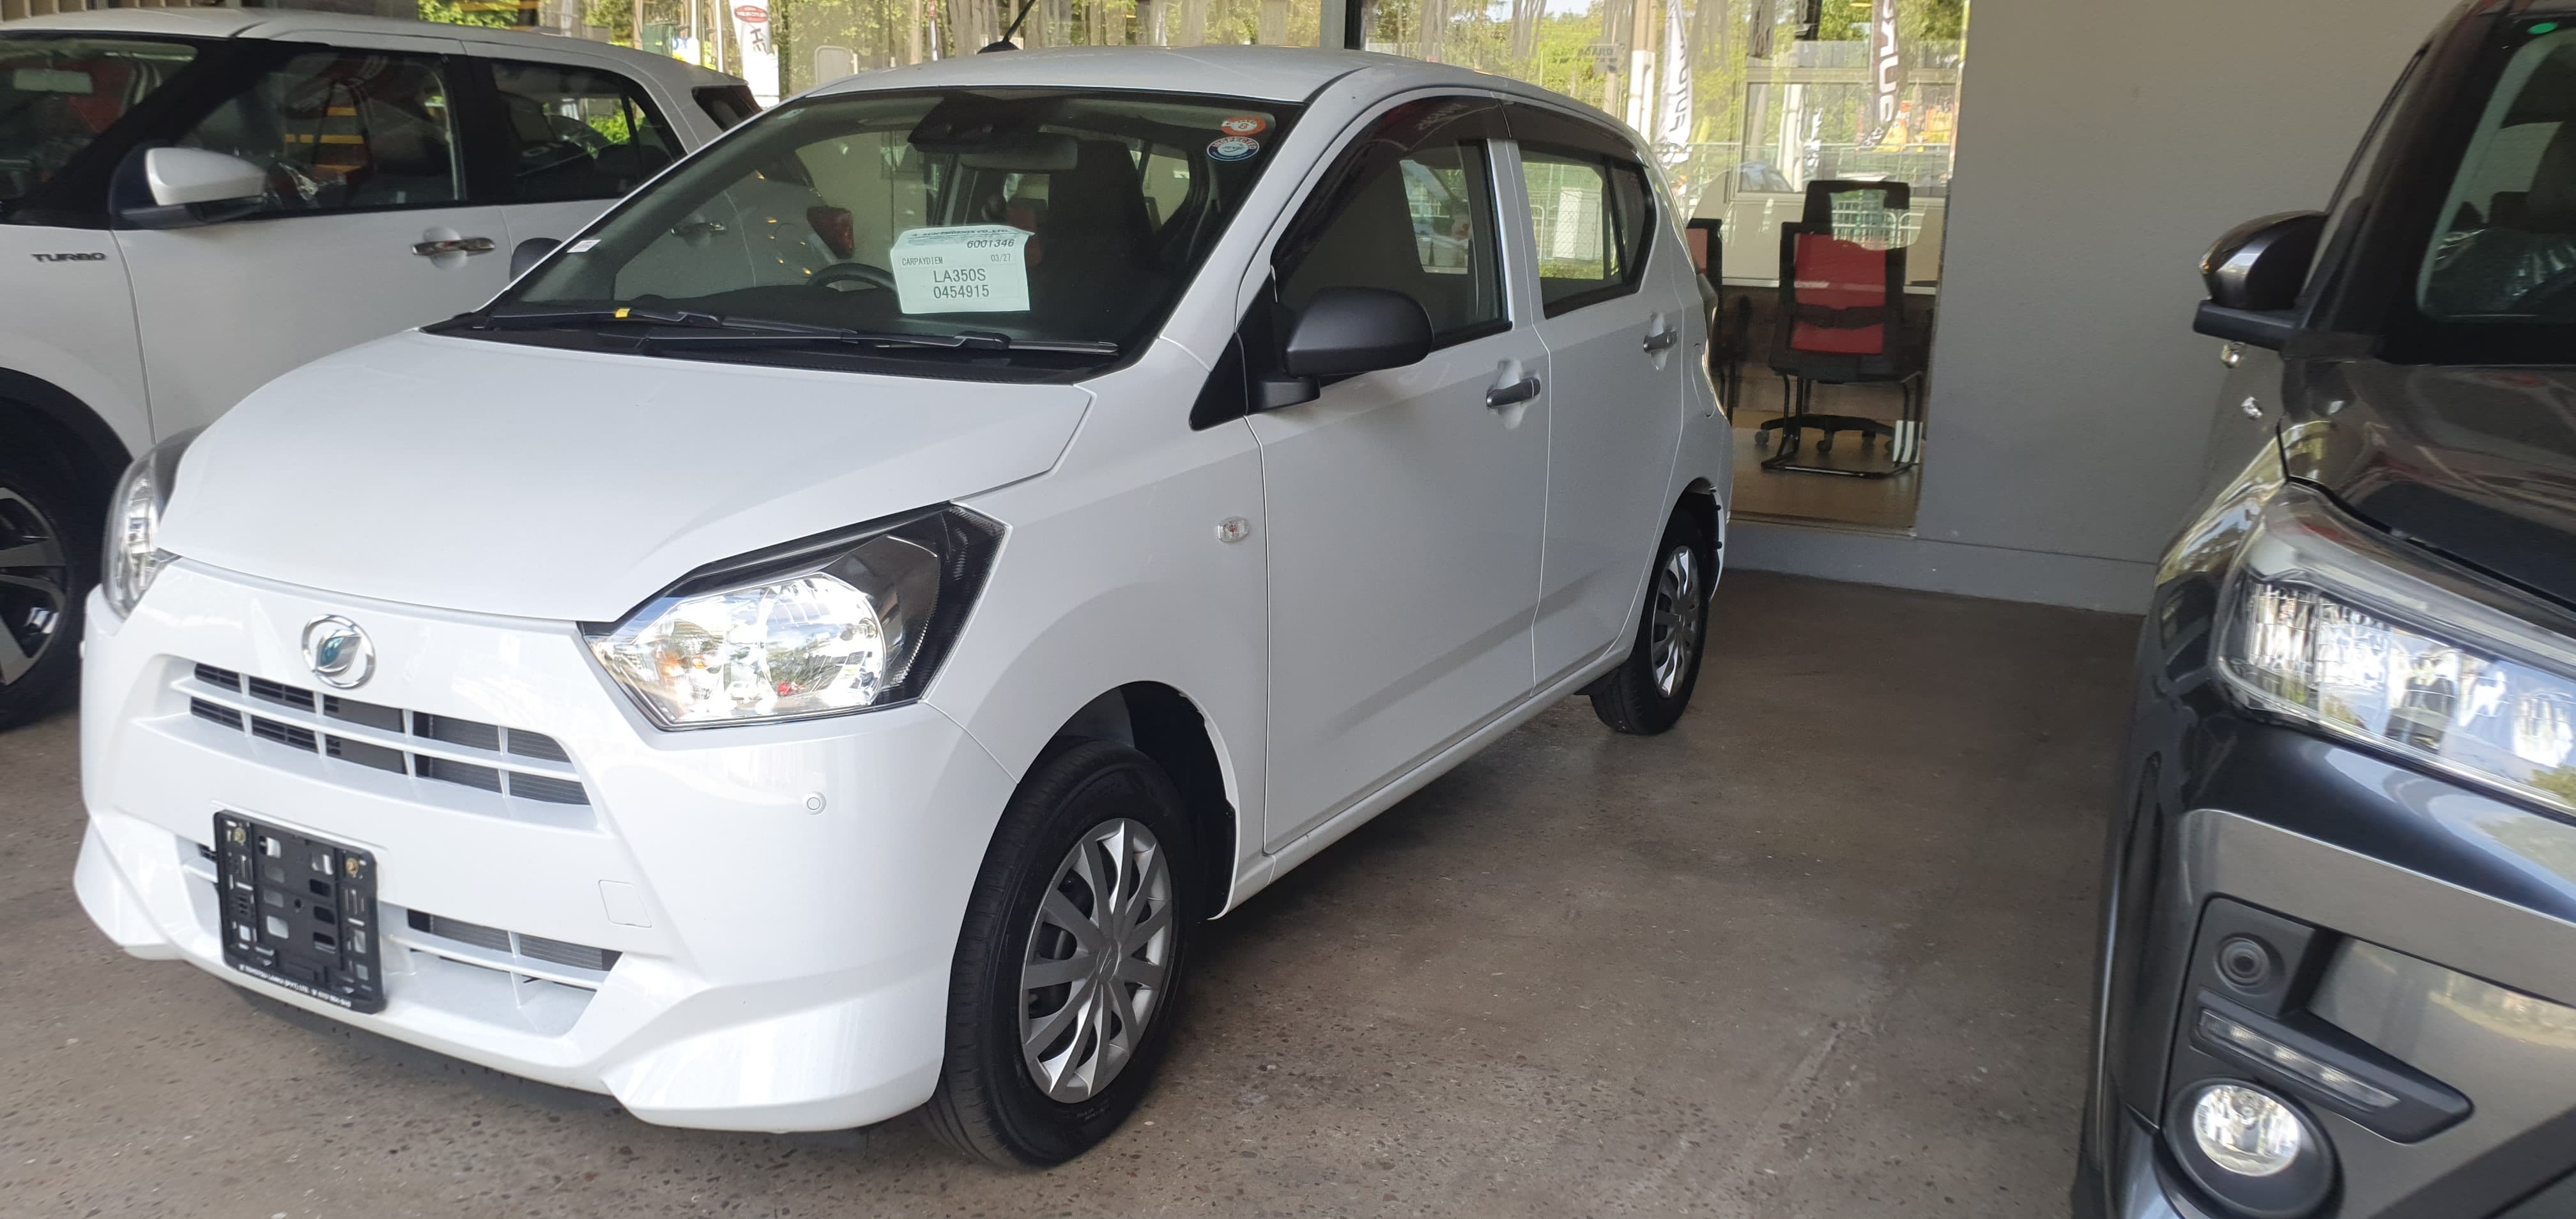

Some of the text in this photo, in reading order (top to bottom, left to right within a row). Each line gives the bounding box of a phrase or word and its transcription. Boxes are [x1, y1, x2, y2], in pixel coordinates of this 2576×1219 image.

[1211, 136, 1257, 150] INSPECTED
[967, 239, 1015, 249] 6001346
[30, 252, 106, 262] TURBO
[901, 256, 943, 266] CARPAYDIEM
[991, 254, 1011, 262] 03/27
[933, 268, 986, 283] LA350S
[933, 284, 990, 299] 0454915
